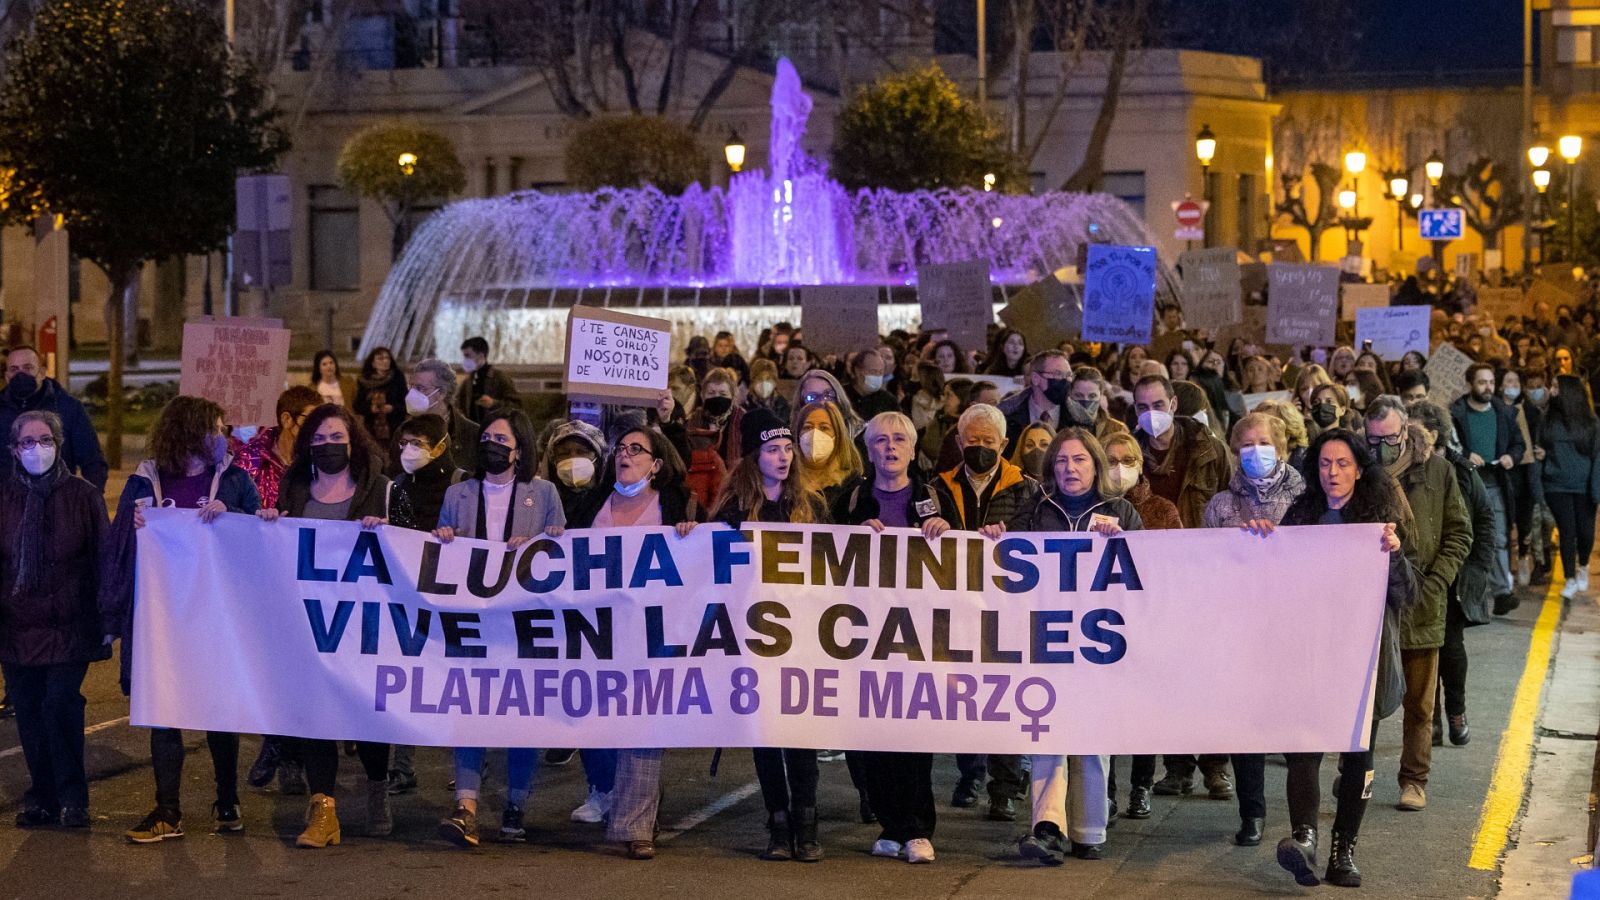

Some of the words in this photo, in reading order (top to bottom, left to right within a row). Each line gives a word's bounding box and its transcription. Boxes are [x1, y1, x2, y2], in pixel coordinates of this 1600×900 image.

[595, 336, 608, 346] DE
[613, 326, 659, 343] CANSAS
[584, 349, 659, 370] NOSOTRAS
[576, 365, 591, 376] DE
[296, 527, 394, 586] LA
[415, 533, 684, 599] LUCHA
[711, 529, 1143, 594] FEMINISTA
[302, 598, 488, 659] VIVE
[511, 606, 613, 660] EN
[644, 600, 793, 659] LAS
[817, 603, 1128, 665] CALLES
[374, 664, 712, 719] PLATAFORMA
[729, 666, 760, 715] 8
[780, 666, 839, 717] DE
